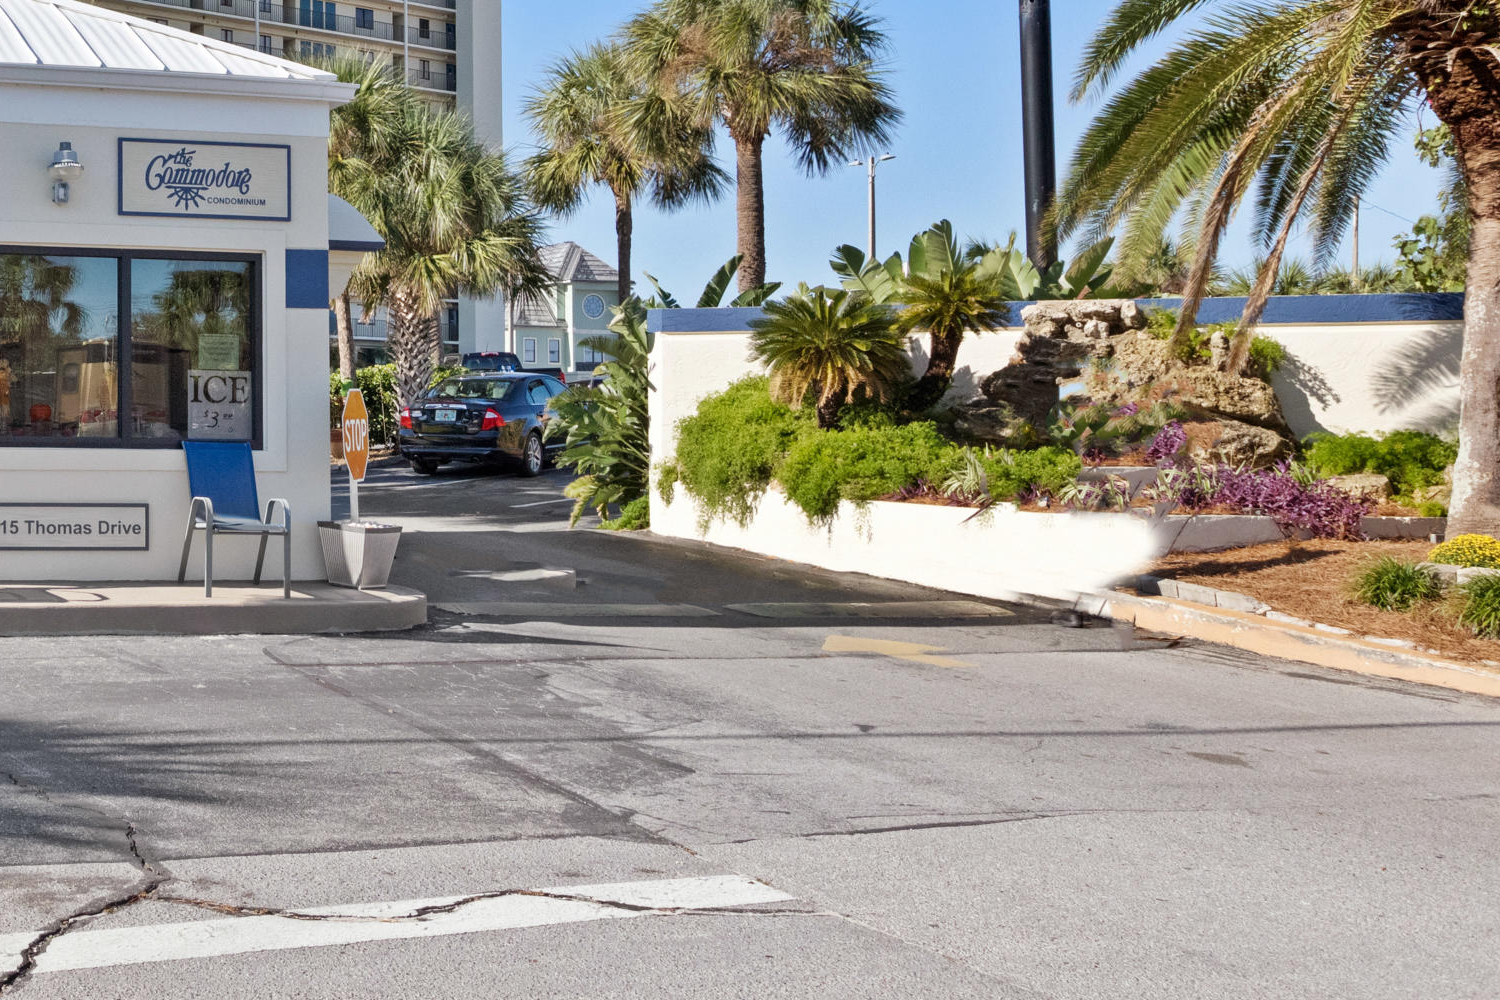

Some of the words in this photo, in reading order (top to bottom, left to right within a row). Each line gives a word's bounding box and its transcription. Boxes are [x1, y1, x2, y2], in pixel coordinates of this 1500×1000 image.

[173, 147, 197, 167] the
[145, 154, 252, 195] Commodore
[207, 197, 266, 206] CONDOMINIUM
[190, 375, 249, 404] ICE
[345, 419, 367, 453] STOP
[24, 520, 92, 535] Thomas
[98, 520, 142, 535] Drive
